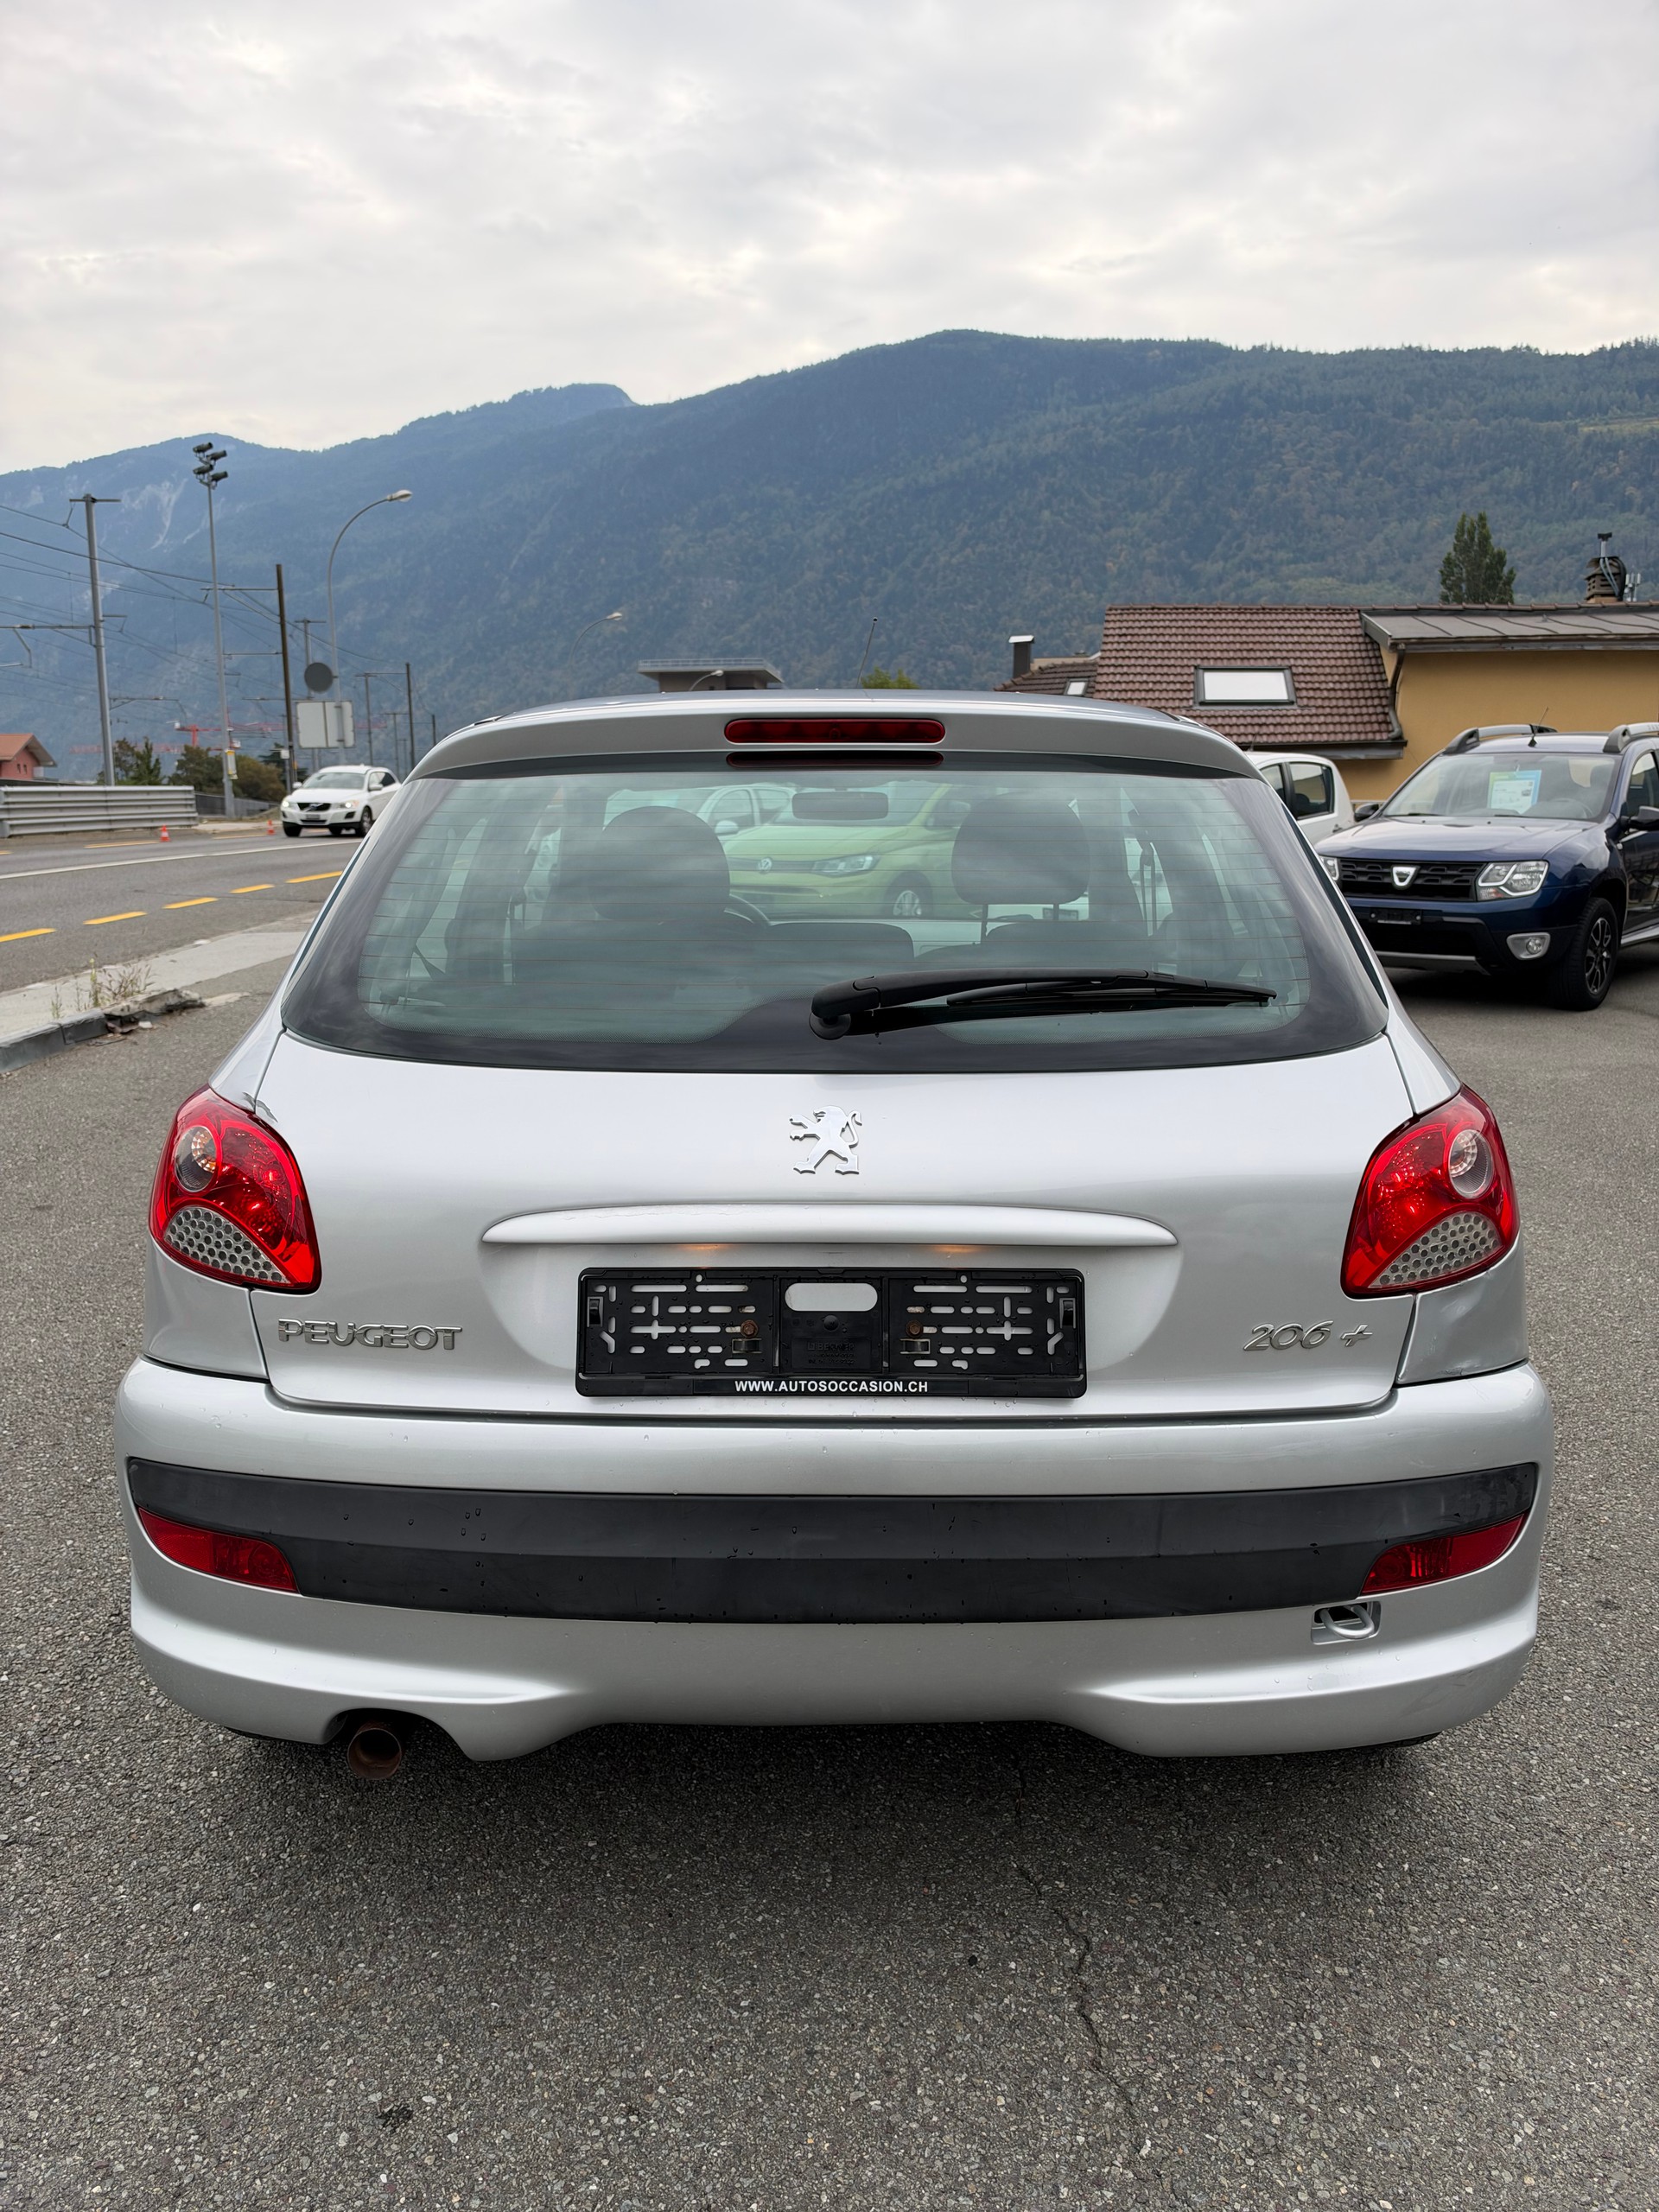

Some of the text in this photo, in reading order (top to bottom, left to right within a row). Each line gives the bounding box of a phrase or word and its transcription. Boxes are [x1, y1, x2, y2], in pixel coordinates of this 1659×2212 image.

[278, 1318, 462, 1351] PEUGEOT
[1243, 1319, 1334, 1351] 206
[734, 1380, 929, 1393] WWW.AUTOSOCCASION.CH
